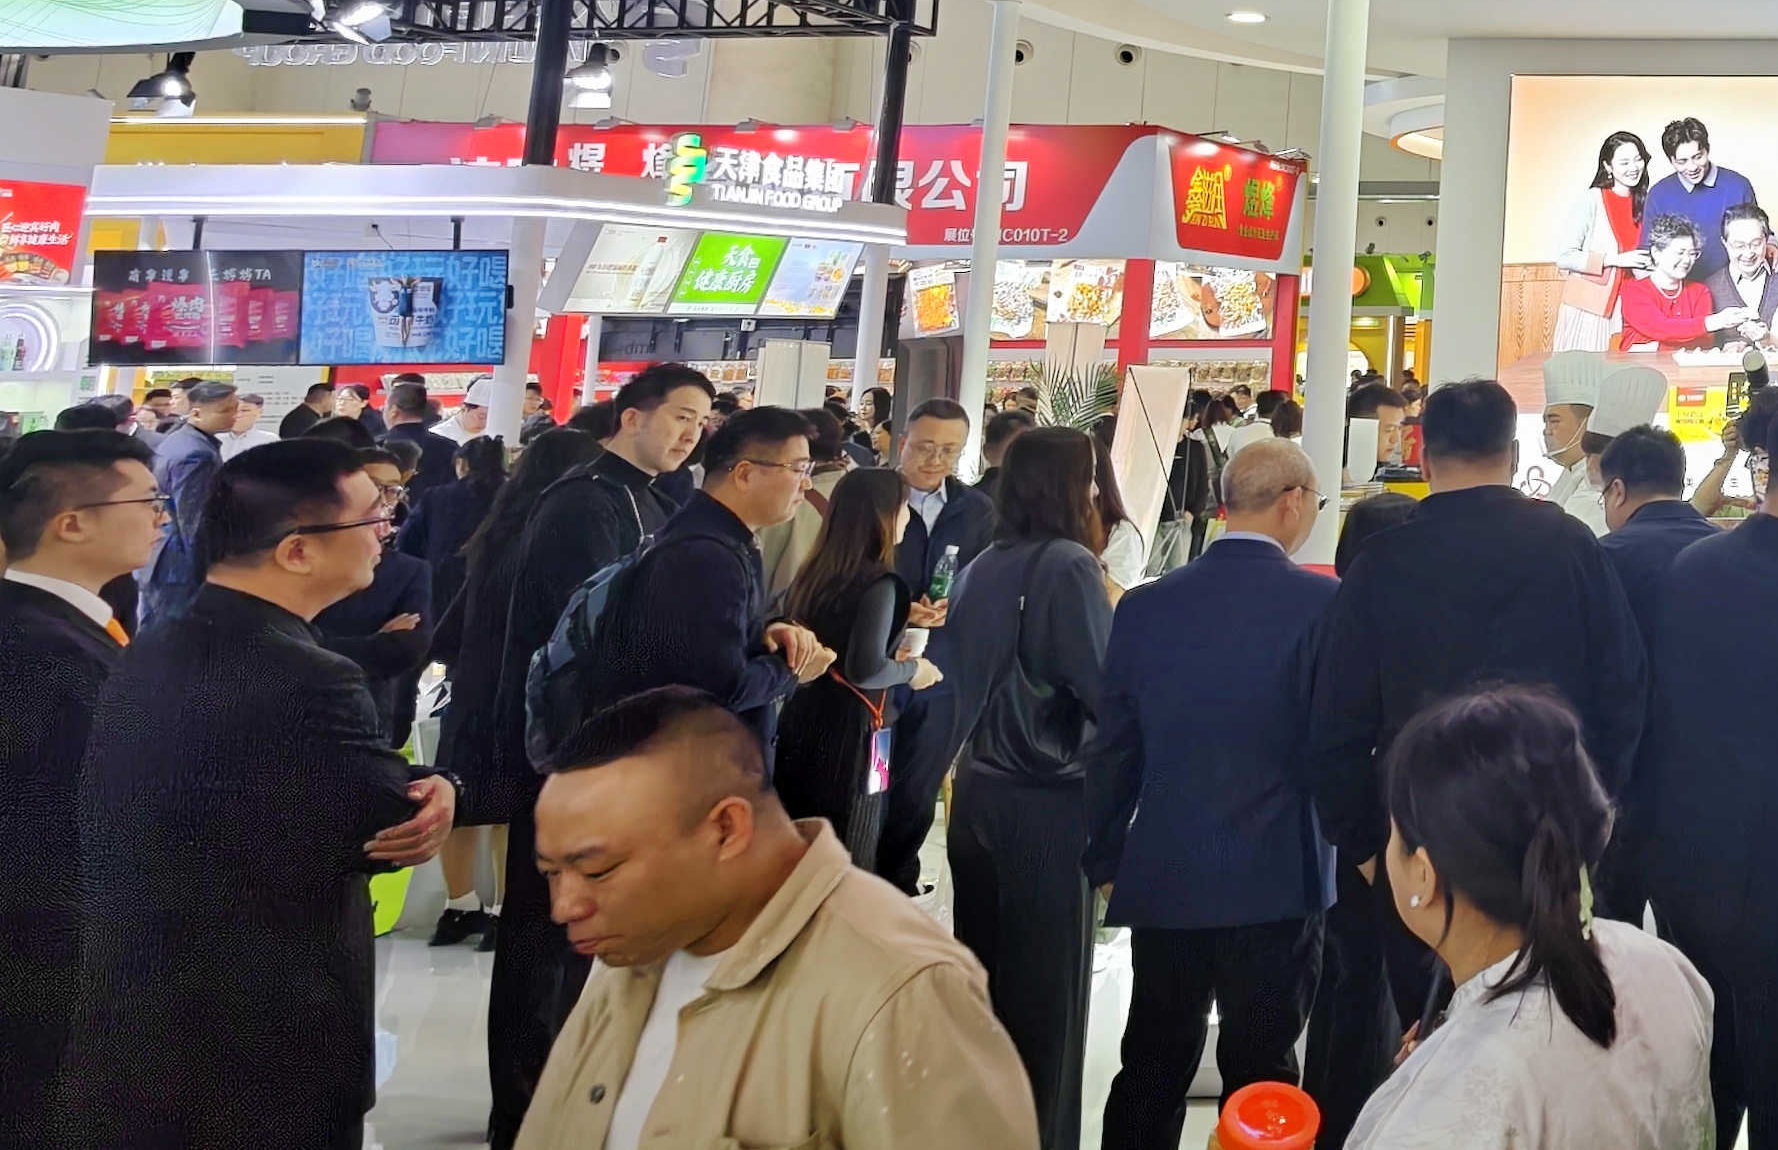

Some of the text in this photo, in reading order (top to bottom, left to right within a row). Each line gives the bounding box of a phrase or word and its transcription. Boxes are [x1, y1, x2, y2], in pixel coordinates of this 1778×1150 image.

[713, 146, 845, 195] 天津食品集团
[711, 183, 843, 214] TIANJIN FOOD GROUP
